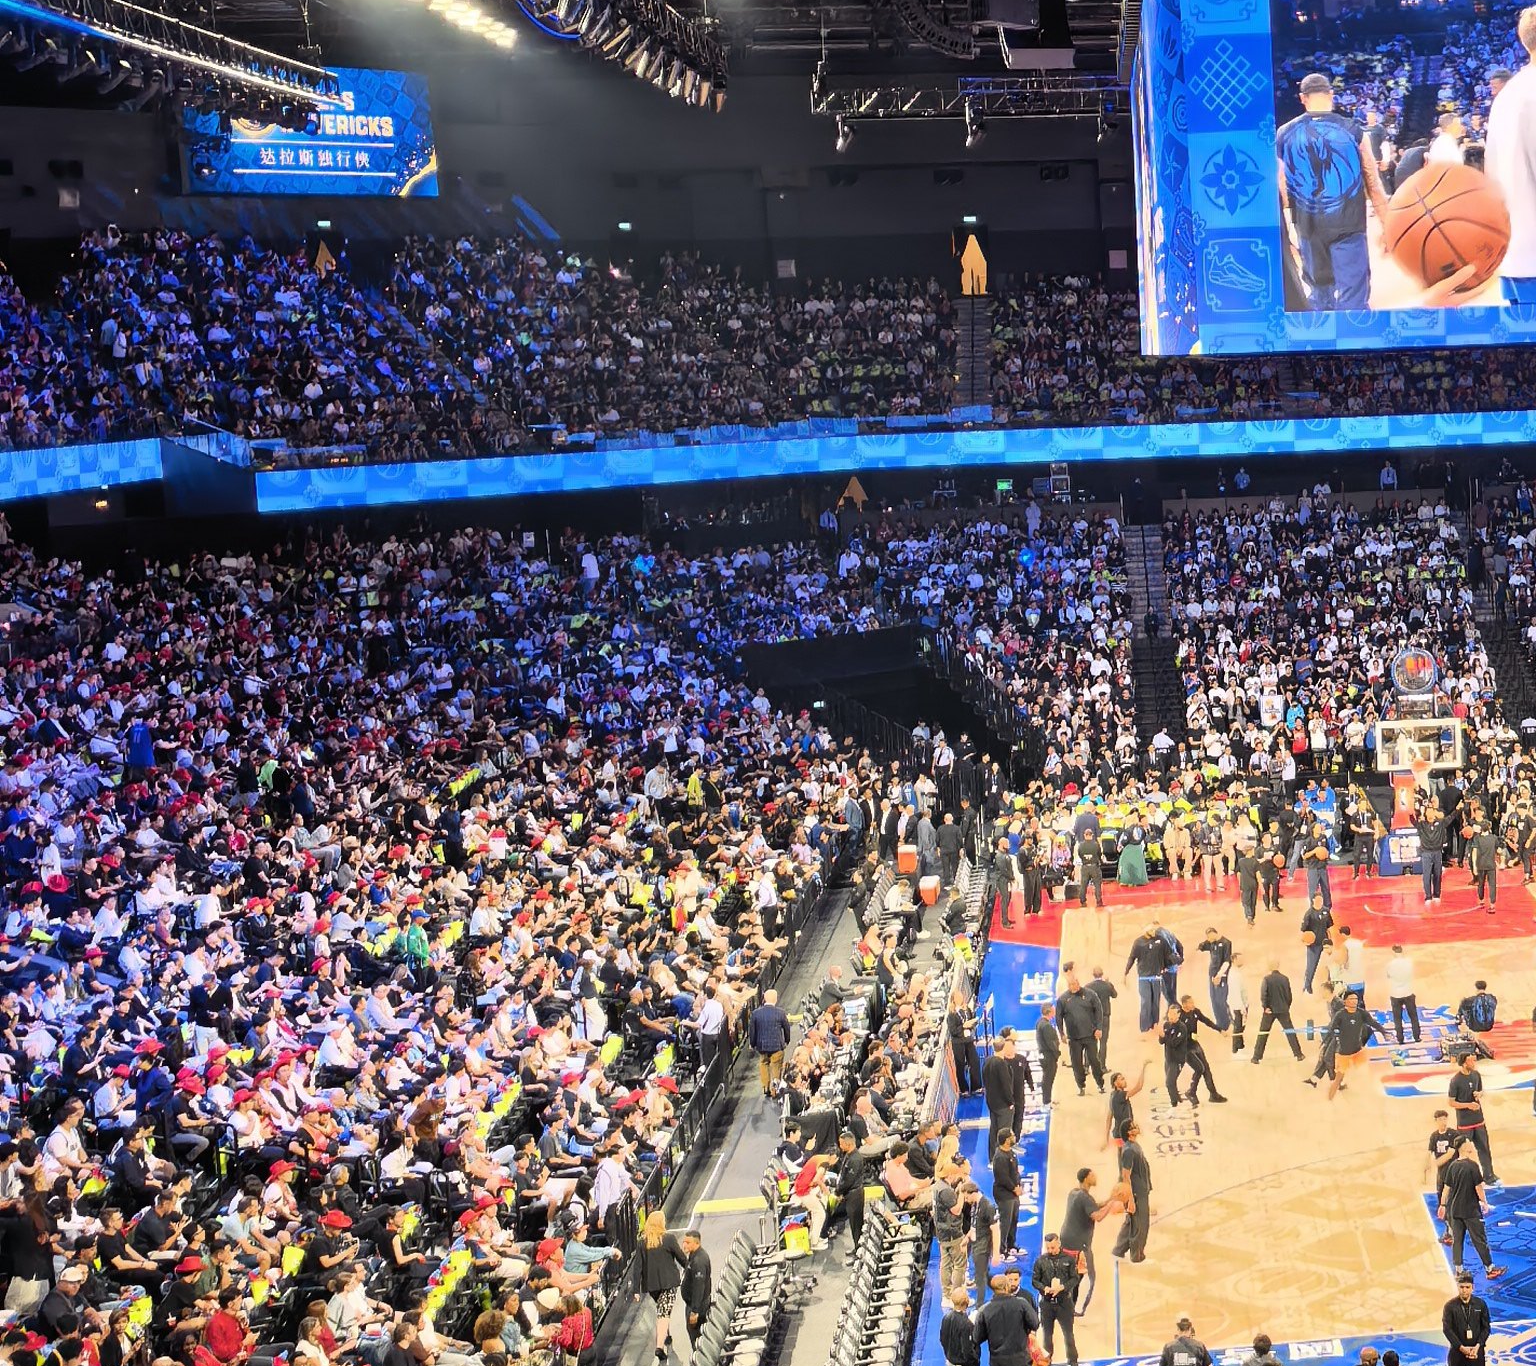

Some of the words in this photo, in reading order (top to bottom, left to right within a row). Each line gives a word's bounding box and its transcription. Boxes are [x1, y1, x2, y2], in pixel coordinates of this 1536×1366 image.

[259, 147, 370, 169] 达拉斯独行侠
